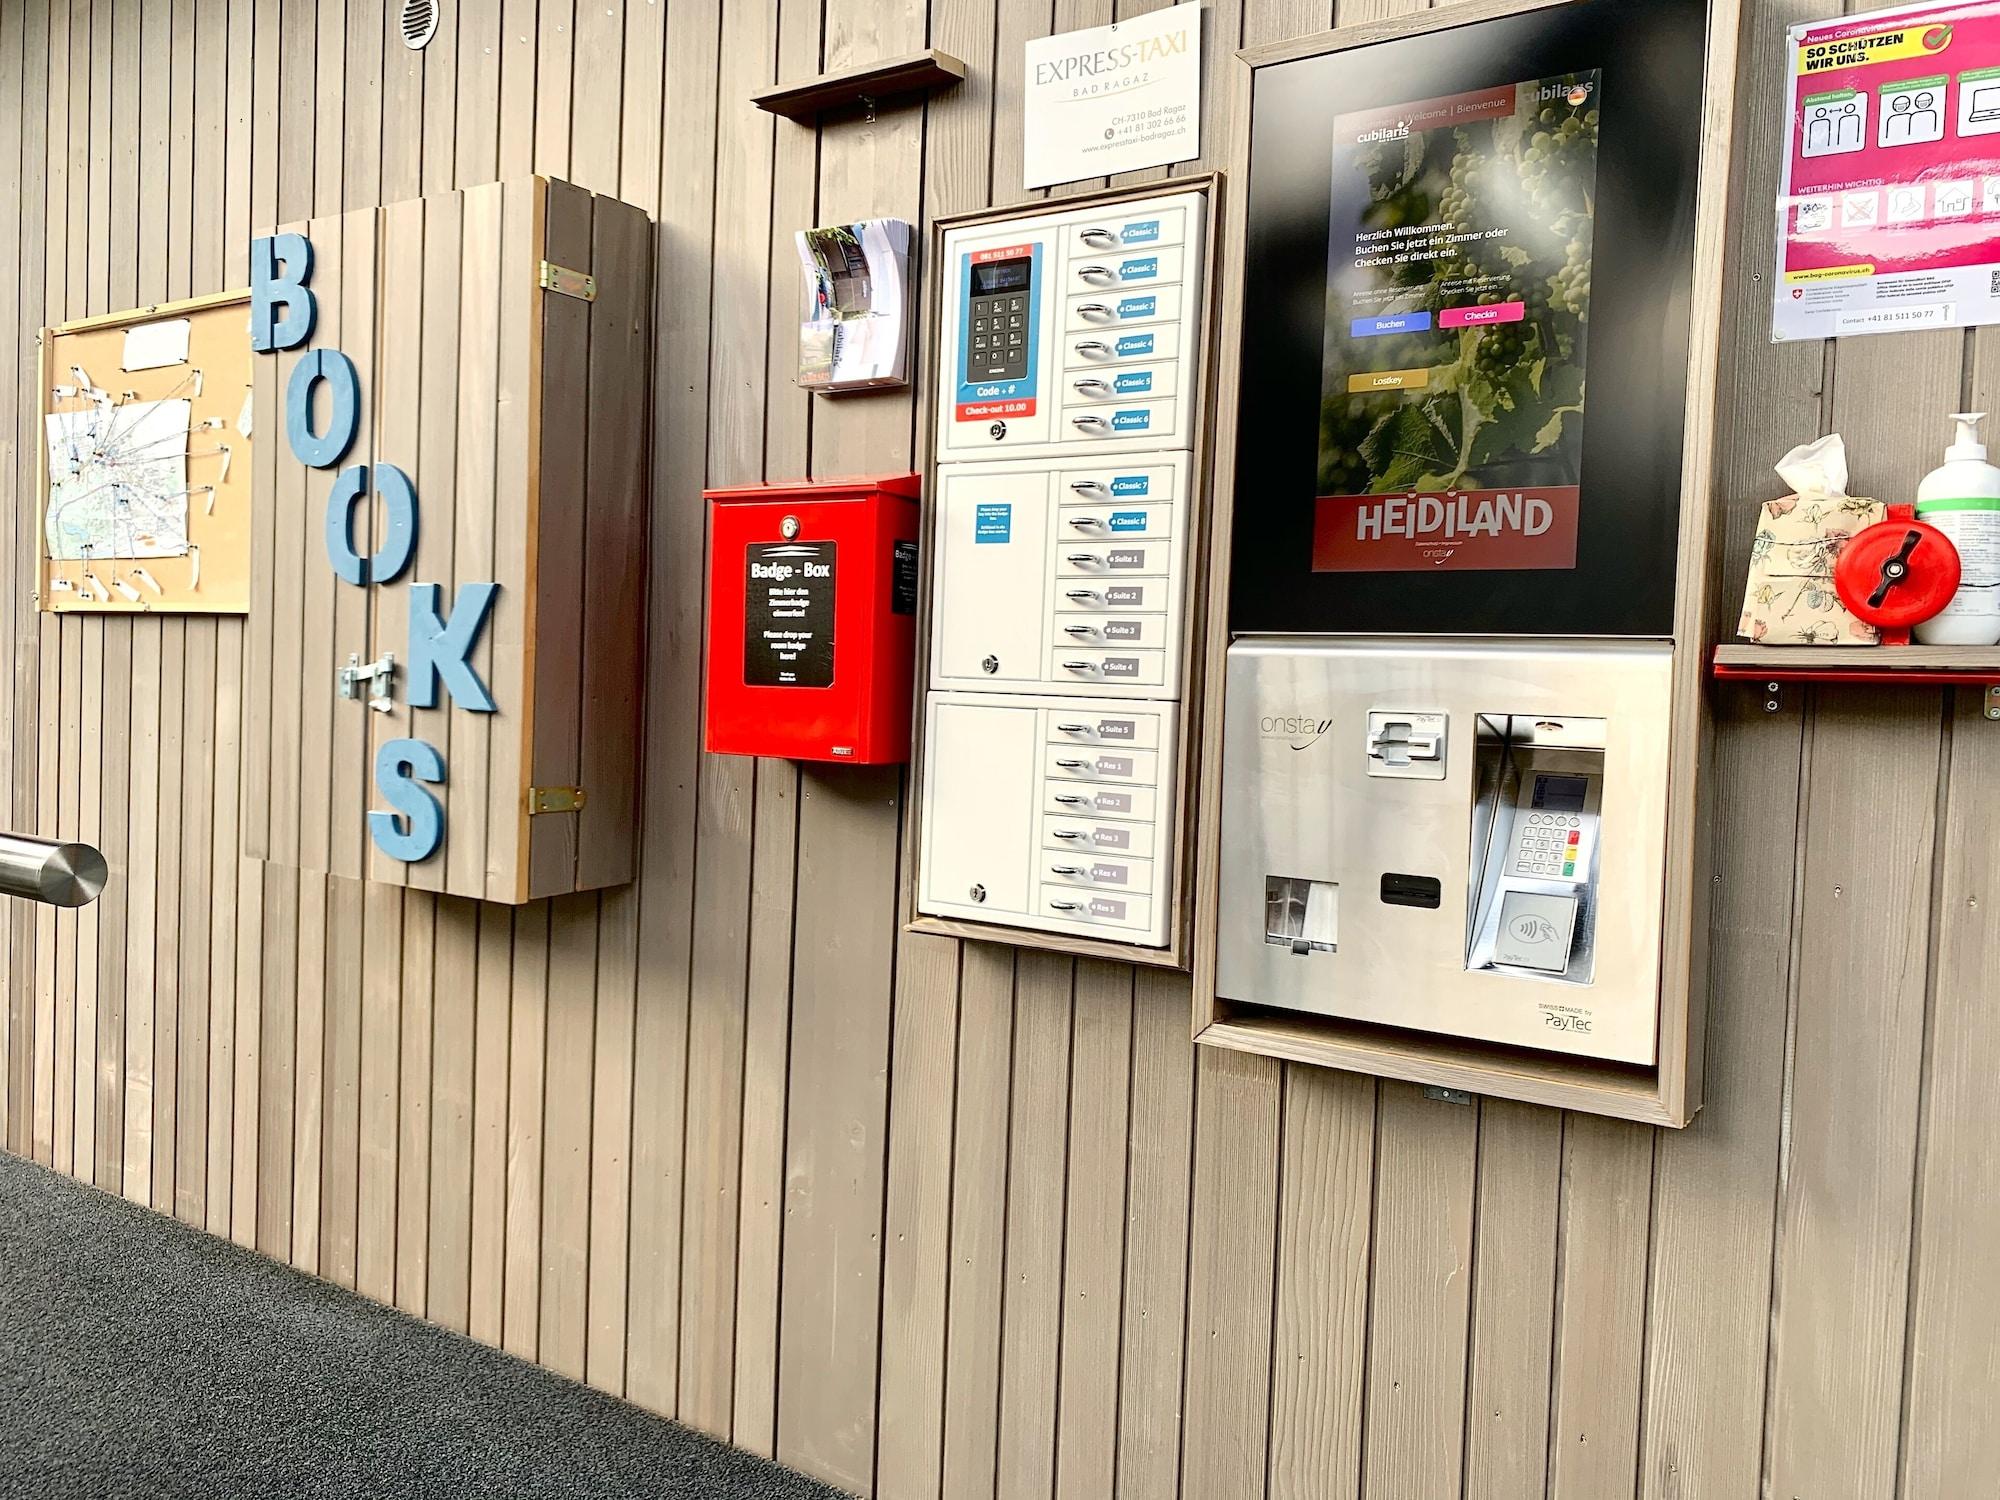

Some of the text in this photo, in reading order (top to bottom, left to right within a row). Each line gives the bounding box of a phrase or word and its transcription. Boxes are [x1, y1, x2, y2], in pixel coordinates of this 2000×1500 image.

[1807, 33, 1833, 43] Neues
[1807, 33, 1904, 59] SO SCHÜTZEN
[1036, 30, 1187, 85] EXPRESS-TAXI
[1806, 52, 1869, 71] WIR UNS.
[1073, 73, 1149, 97] BAD RAGAZ
[1404, 97, 1506, 121] Welcome Bienvenue
[1135, 122, 1145, 132] 81
[1357, 123, 1410, 143] cubilaris
[1798, 181, 1844, 194] WEITERHIN
[1356, 222, 1455, 242] Herzlich Willkommen.
[1355, 227, 1508, 255] Buchen Sie jetzt ein Zimmer oder
[1354, 248, 1458, 268] Checken Sie direkt ein.
[1127, 265, 1149, 273] Classic
[1125, 303, 1149, 312] Classic
[1464, 310, 1498, 321] Checkin
[1883, 313, 1893, 321] 81
[1895, 311, 1910, 320] 511
[1911, 310, 1922, 319] 50
[1923, 309, 1934, 318] 77
[1376, 319, 1406, 330] Buchen
[1123, 341, 1146, 349] Classic
[1121, 379, 1145, 387] Classic
[1373, 375, 1403, 387] Lostkey
[976, 385, 1000, 397] Code
[1008, 384, 1016, 395] #
[965, 405, 1003, 416] Check-out
[1119, 416, 1143, 424] Classic
[1118, 481, 1142, 489] Classic
[252, 233, 501, 864] BOOKS
[751, 562, 792, 581] Badge
[803, 562, 830, 578] Box
[1545, 1012, 1592, 1031] PayTec
